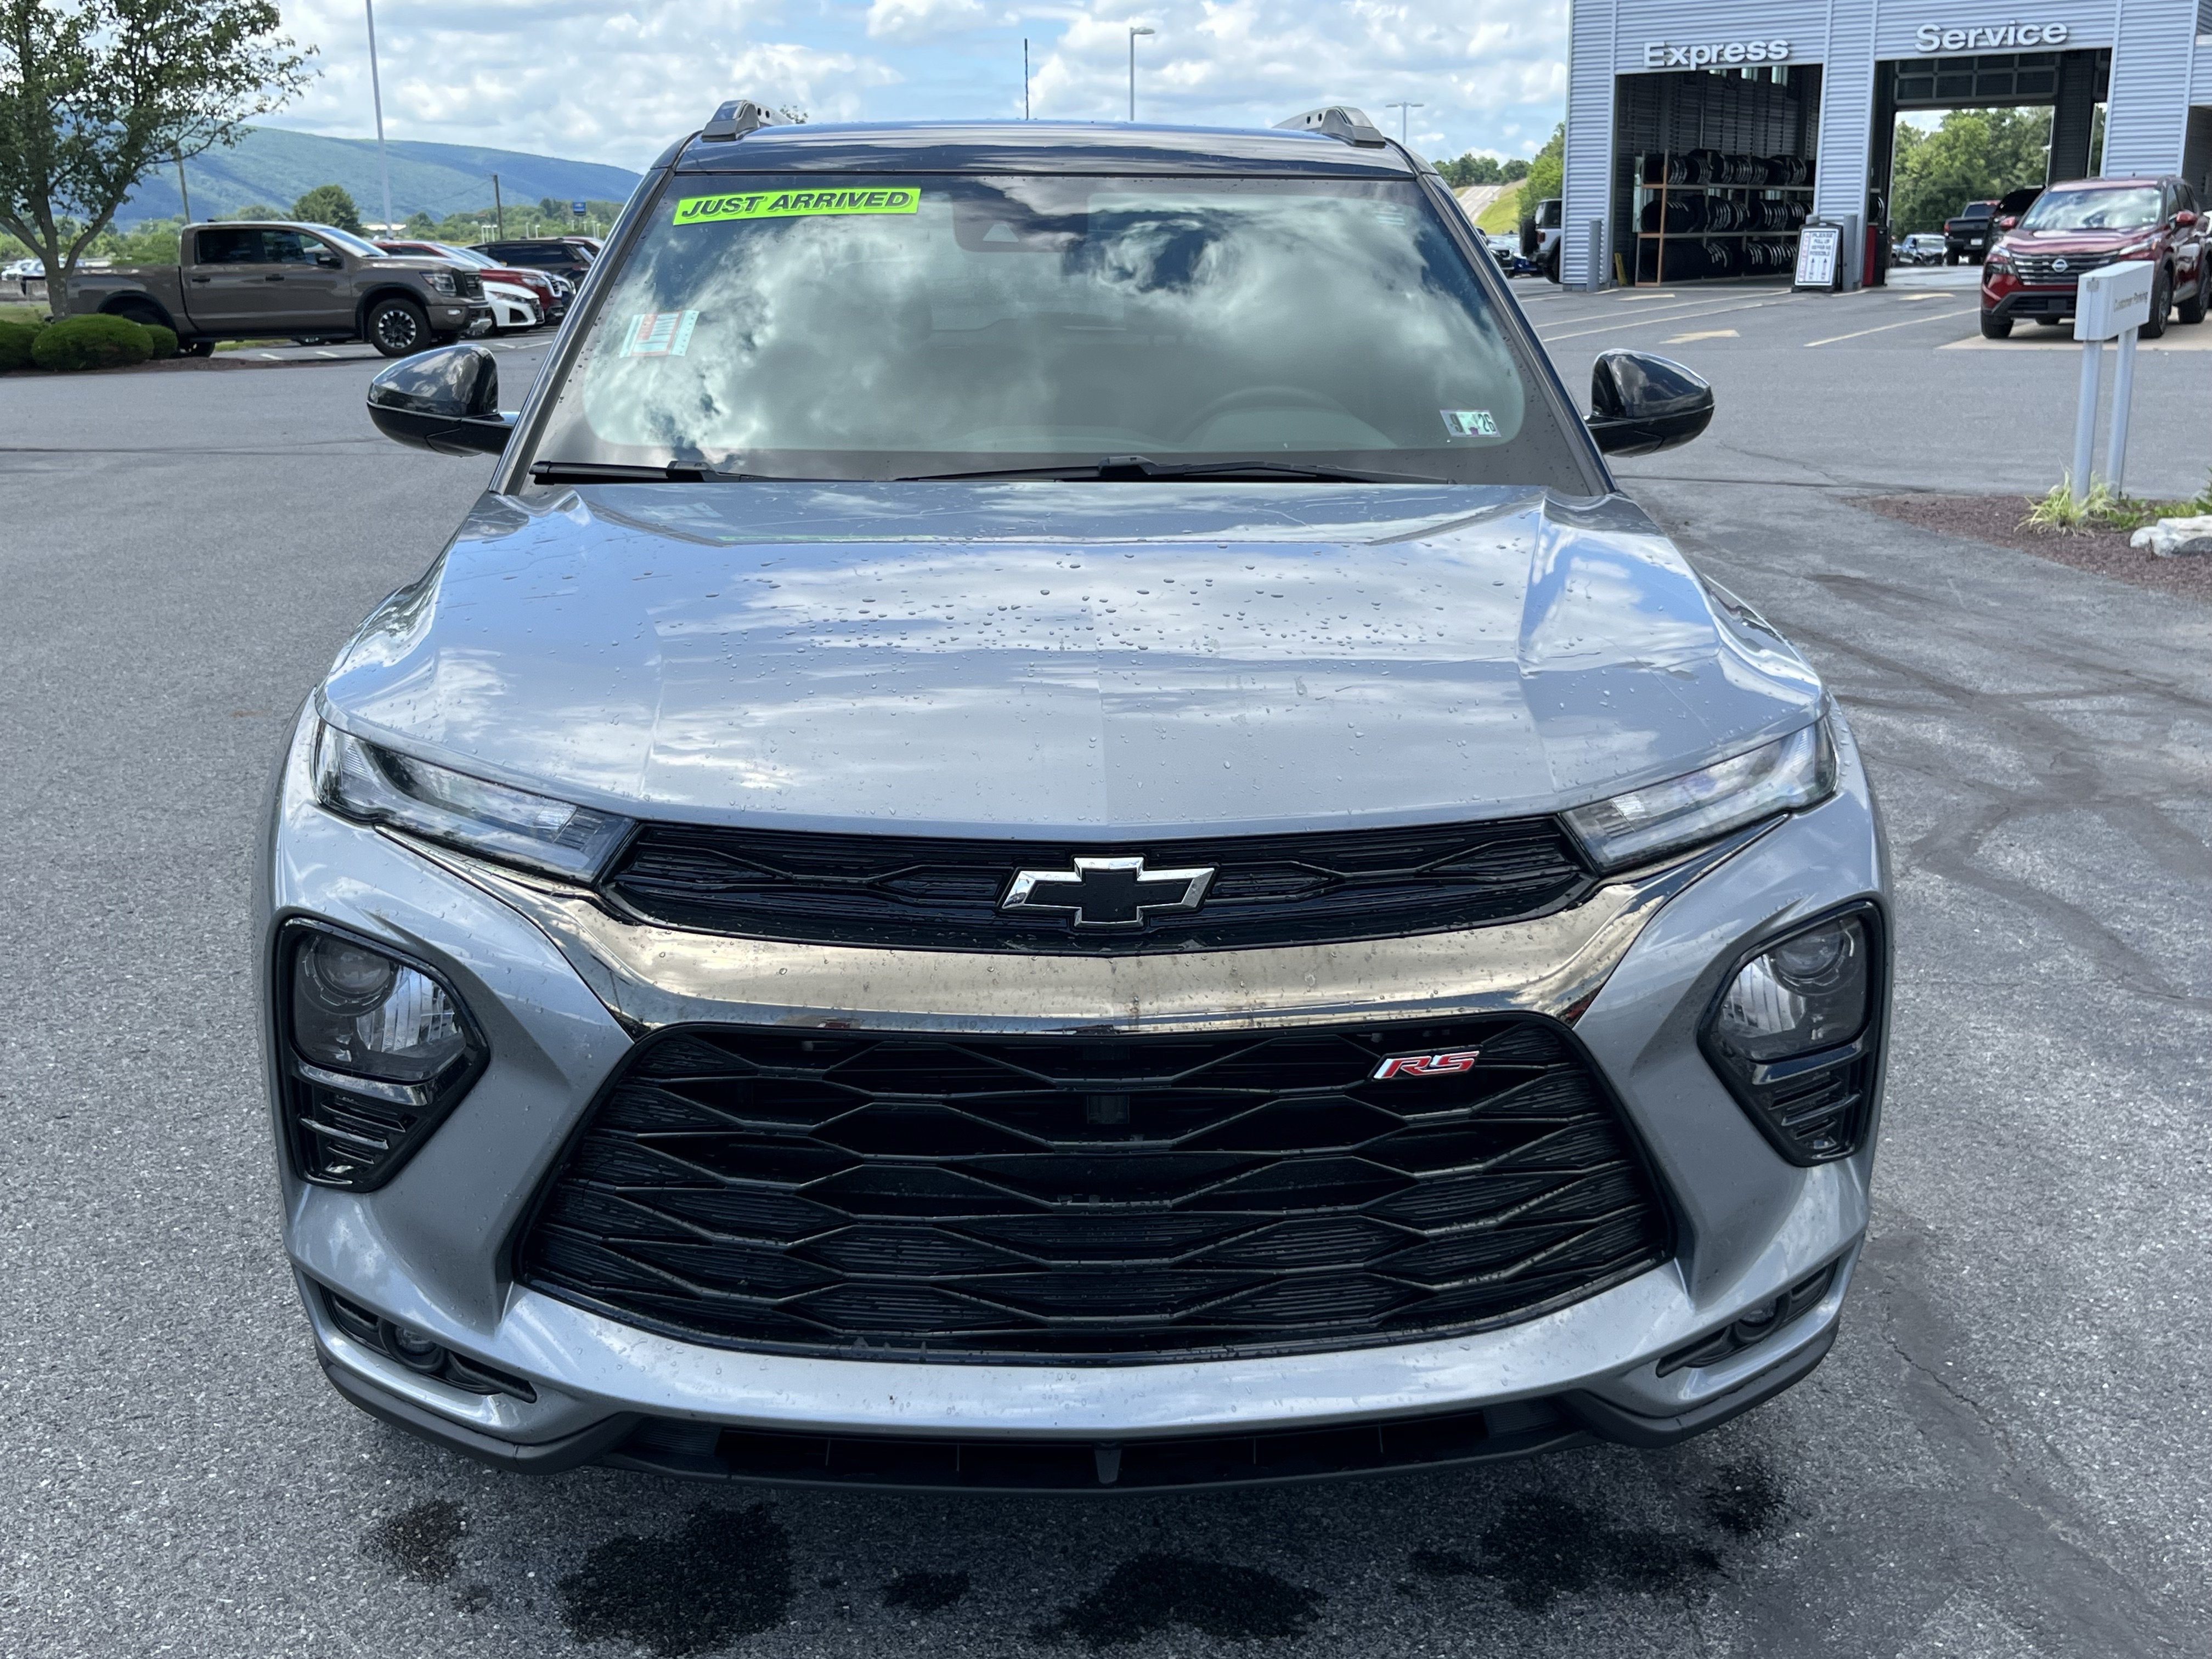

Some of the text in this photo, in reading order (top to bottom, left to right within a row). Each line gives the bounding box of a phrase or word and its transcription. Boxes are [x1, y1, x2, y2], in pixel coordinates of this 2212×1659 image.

[1643, 20, 2068, 70] Express Service
[681, 191, 913, 217] JUST ARRIVED
[1373, 1051, 1480, 1079] RS
